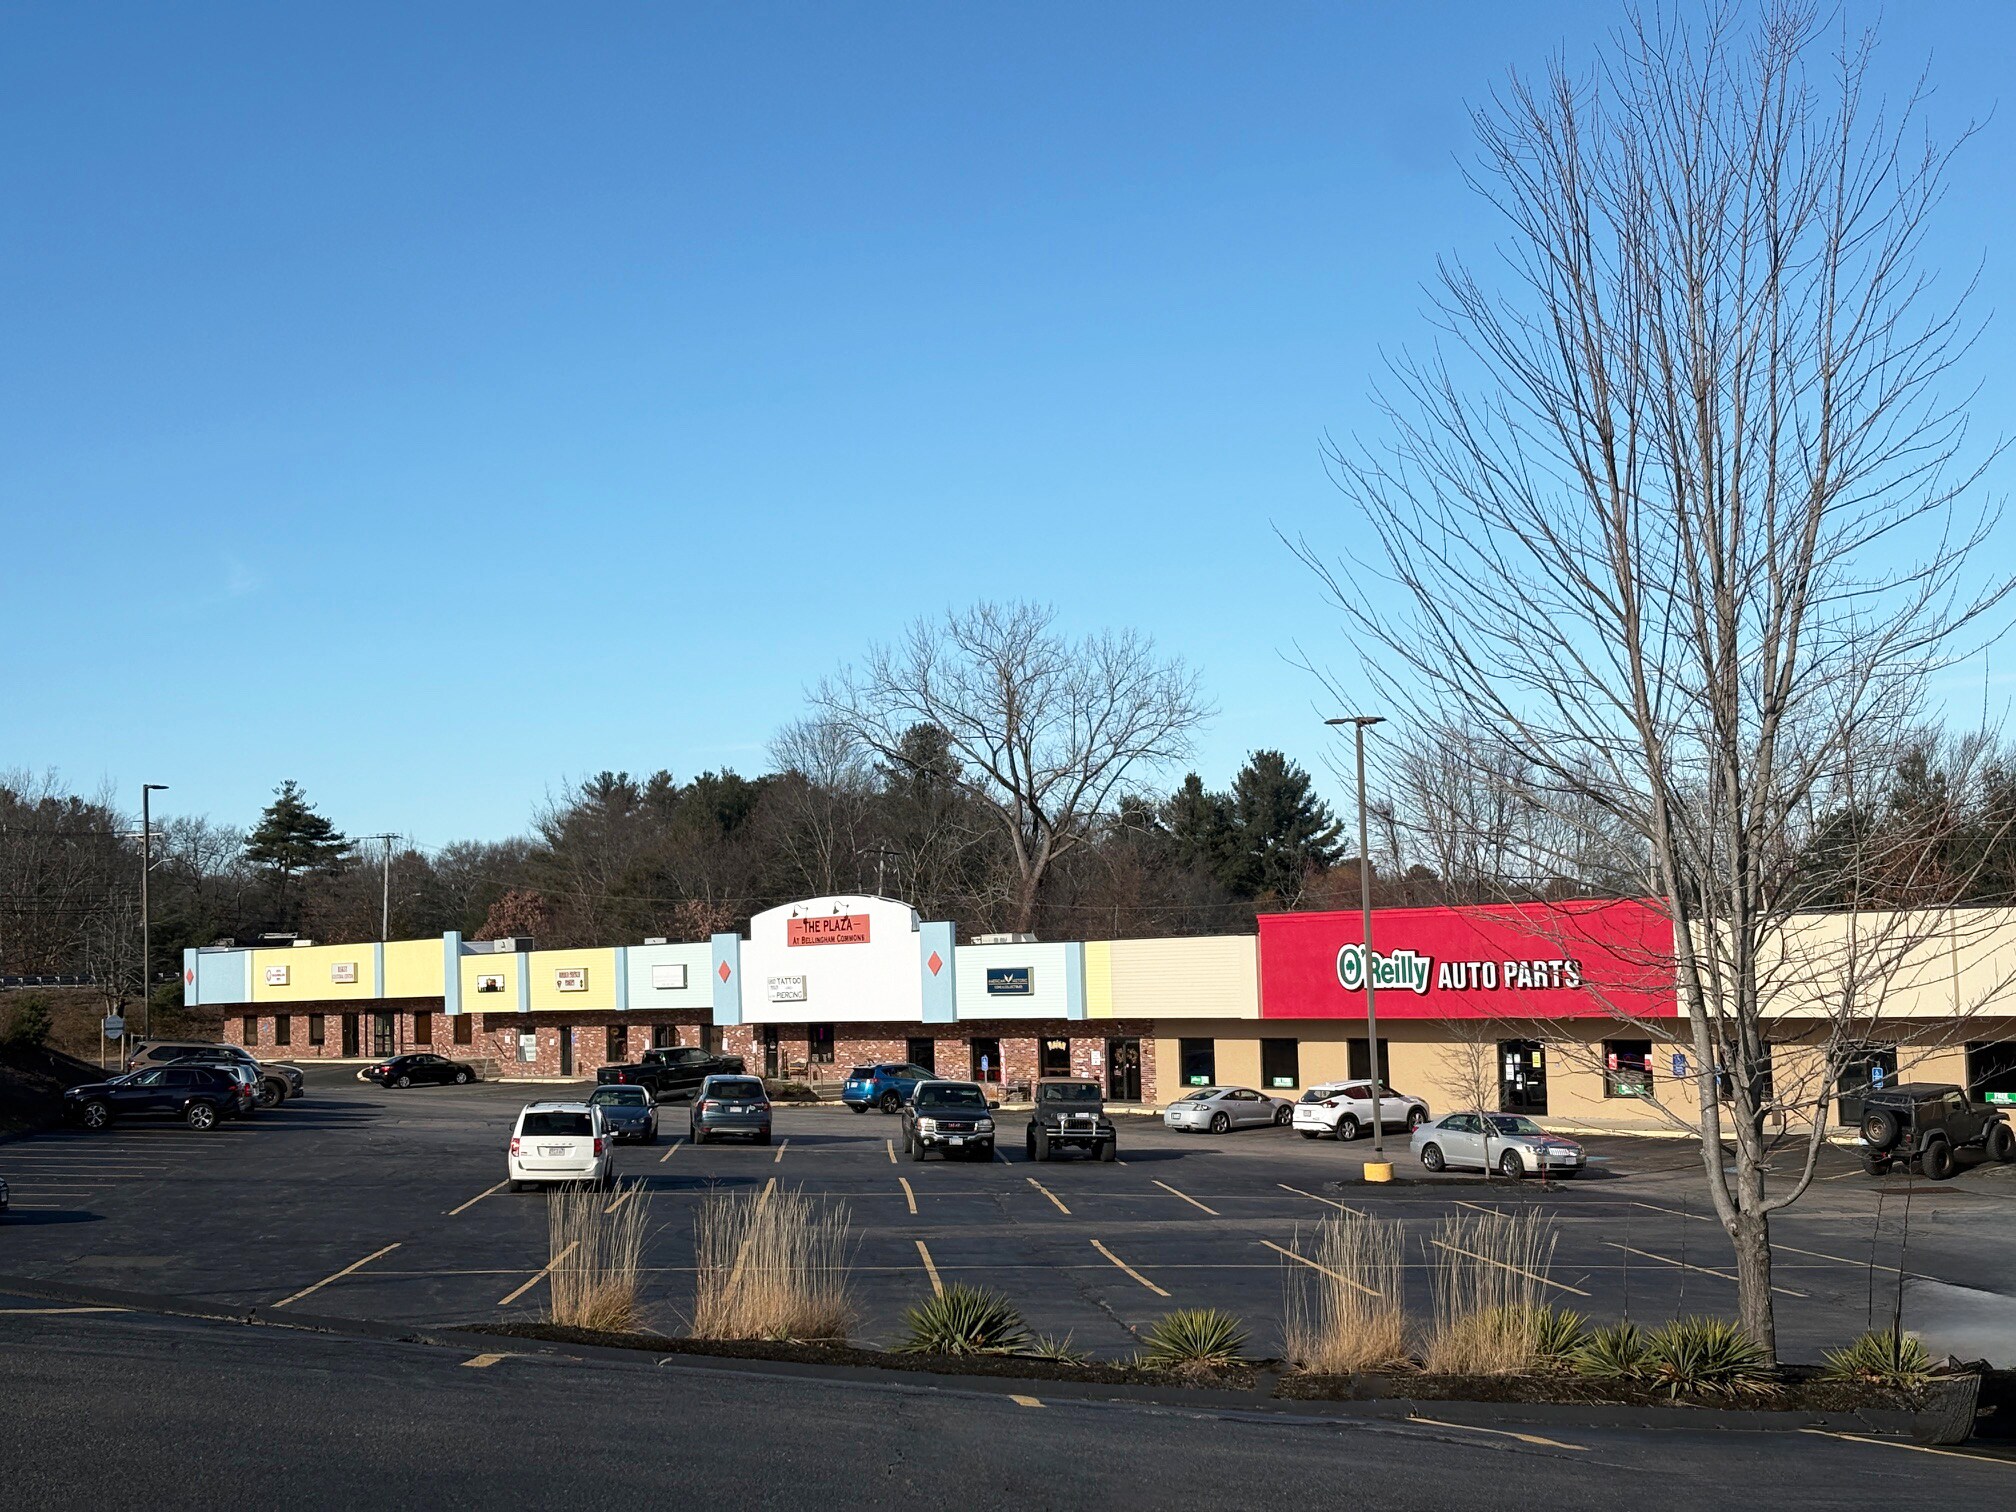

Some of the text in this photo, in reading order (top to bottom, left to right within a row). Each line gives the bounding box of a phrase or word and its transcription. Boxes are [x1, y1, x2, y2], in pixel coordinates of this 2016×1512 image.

[803, 918, 853, 933] THE PLAZA
[1339, 947, 1581, 991] O'Reilly AUTO PARTS
[776, 977, 802, 985] TATTOO
[776, 990, 803, 999] PIERCING
